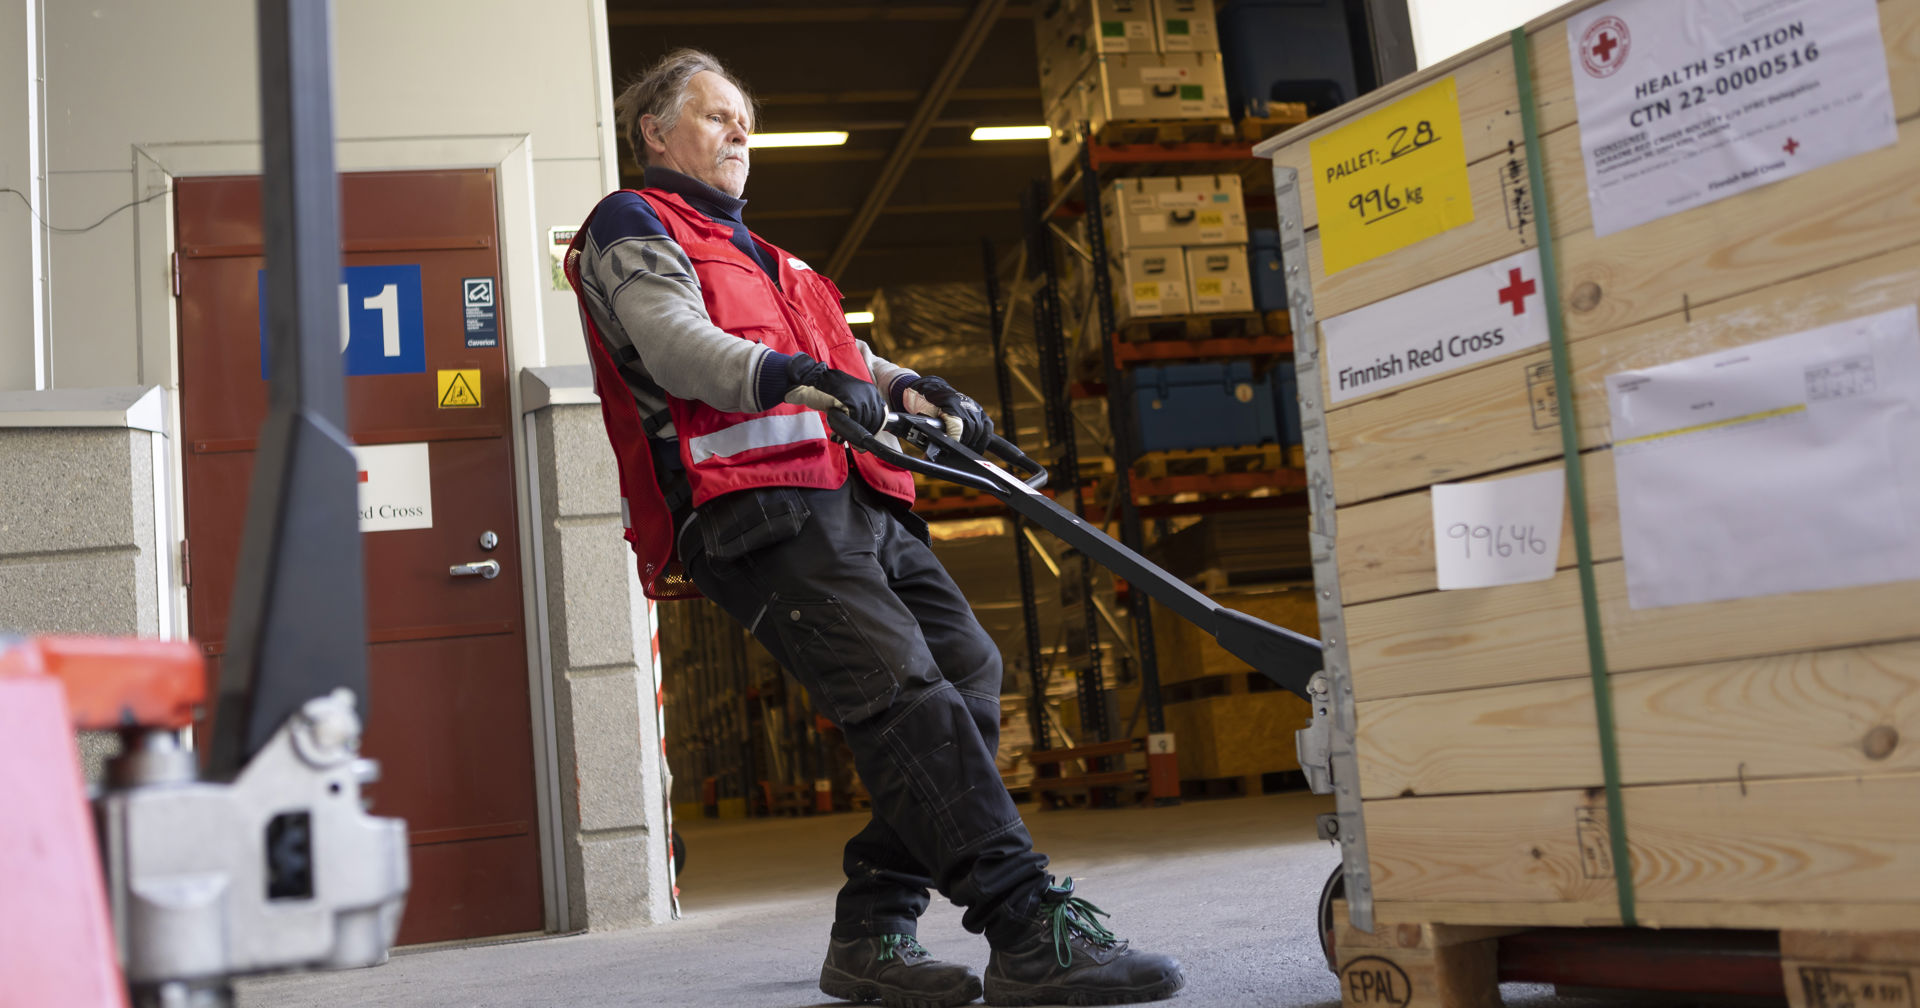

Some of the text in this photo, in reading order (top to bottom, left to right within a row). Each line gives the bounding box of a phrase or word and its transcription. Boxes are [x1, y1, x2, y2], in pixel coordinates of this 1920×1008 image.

[1630, 97, 1672, 128] CTN
[1678, 41, 1819, 111] 22-0000516
[1635, 20, 1804, 100] HEALTH STATION
[1326, 120, 1434, 184] PALLET: 28
[1348, 183, 1425, 218] 996 kg
[1338, 327, 1505, 391] Finnish Red Cross
[358, 504, 423, 520] ed Cross
[1446, 522, 1547, 559] 99646
[1348, 969, 1403, 1004] EPAL
